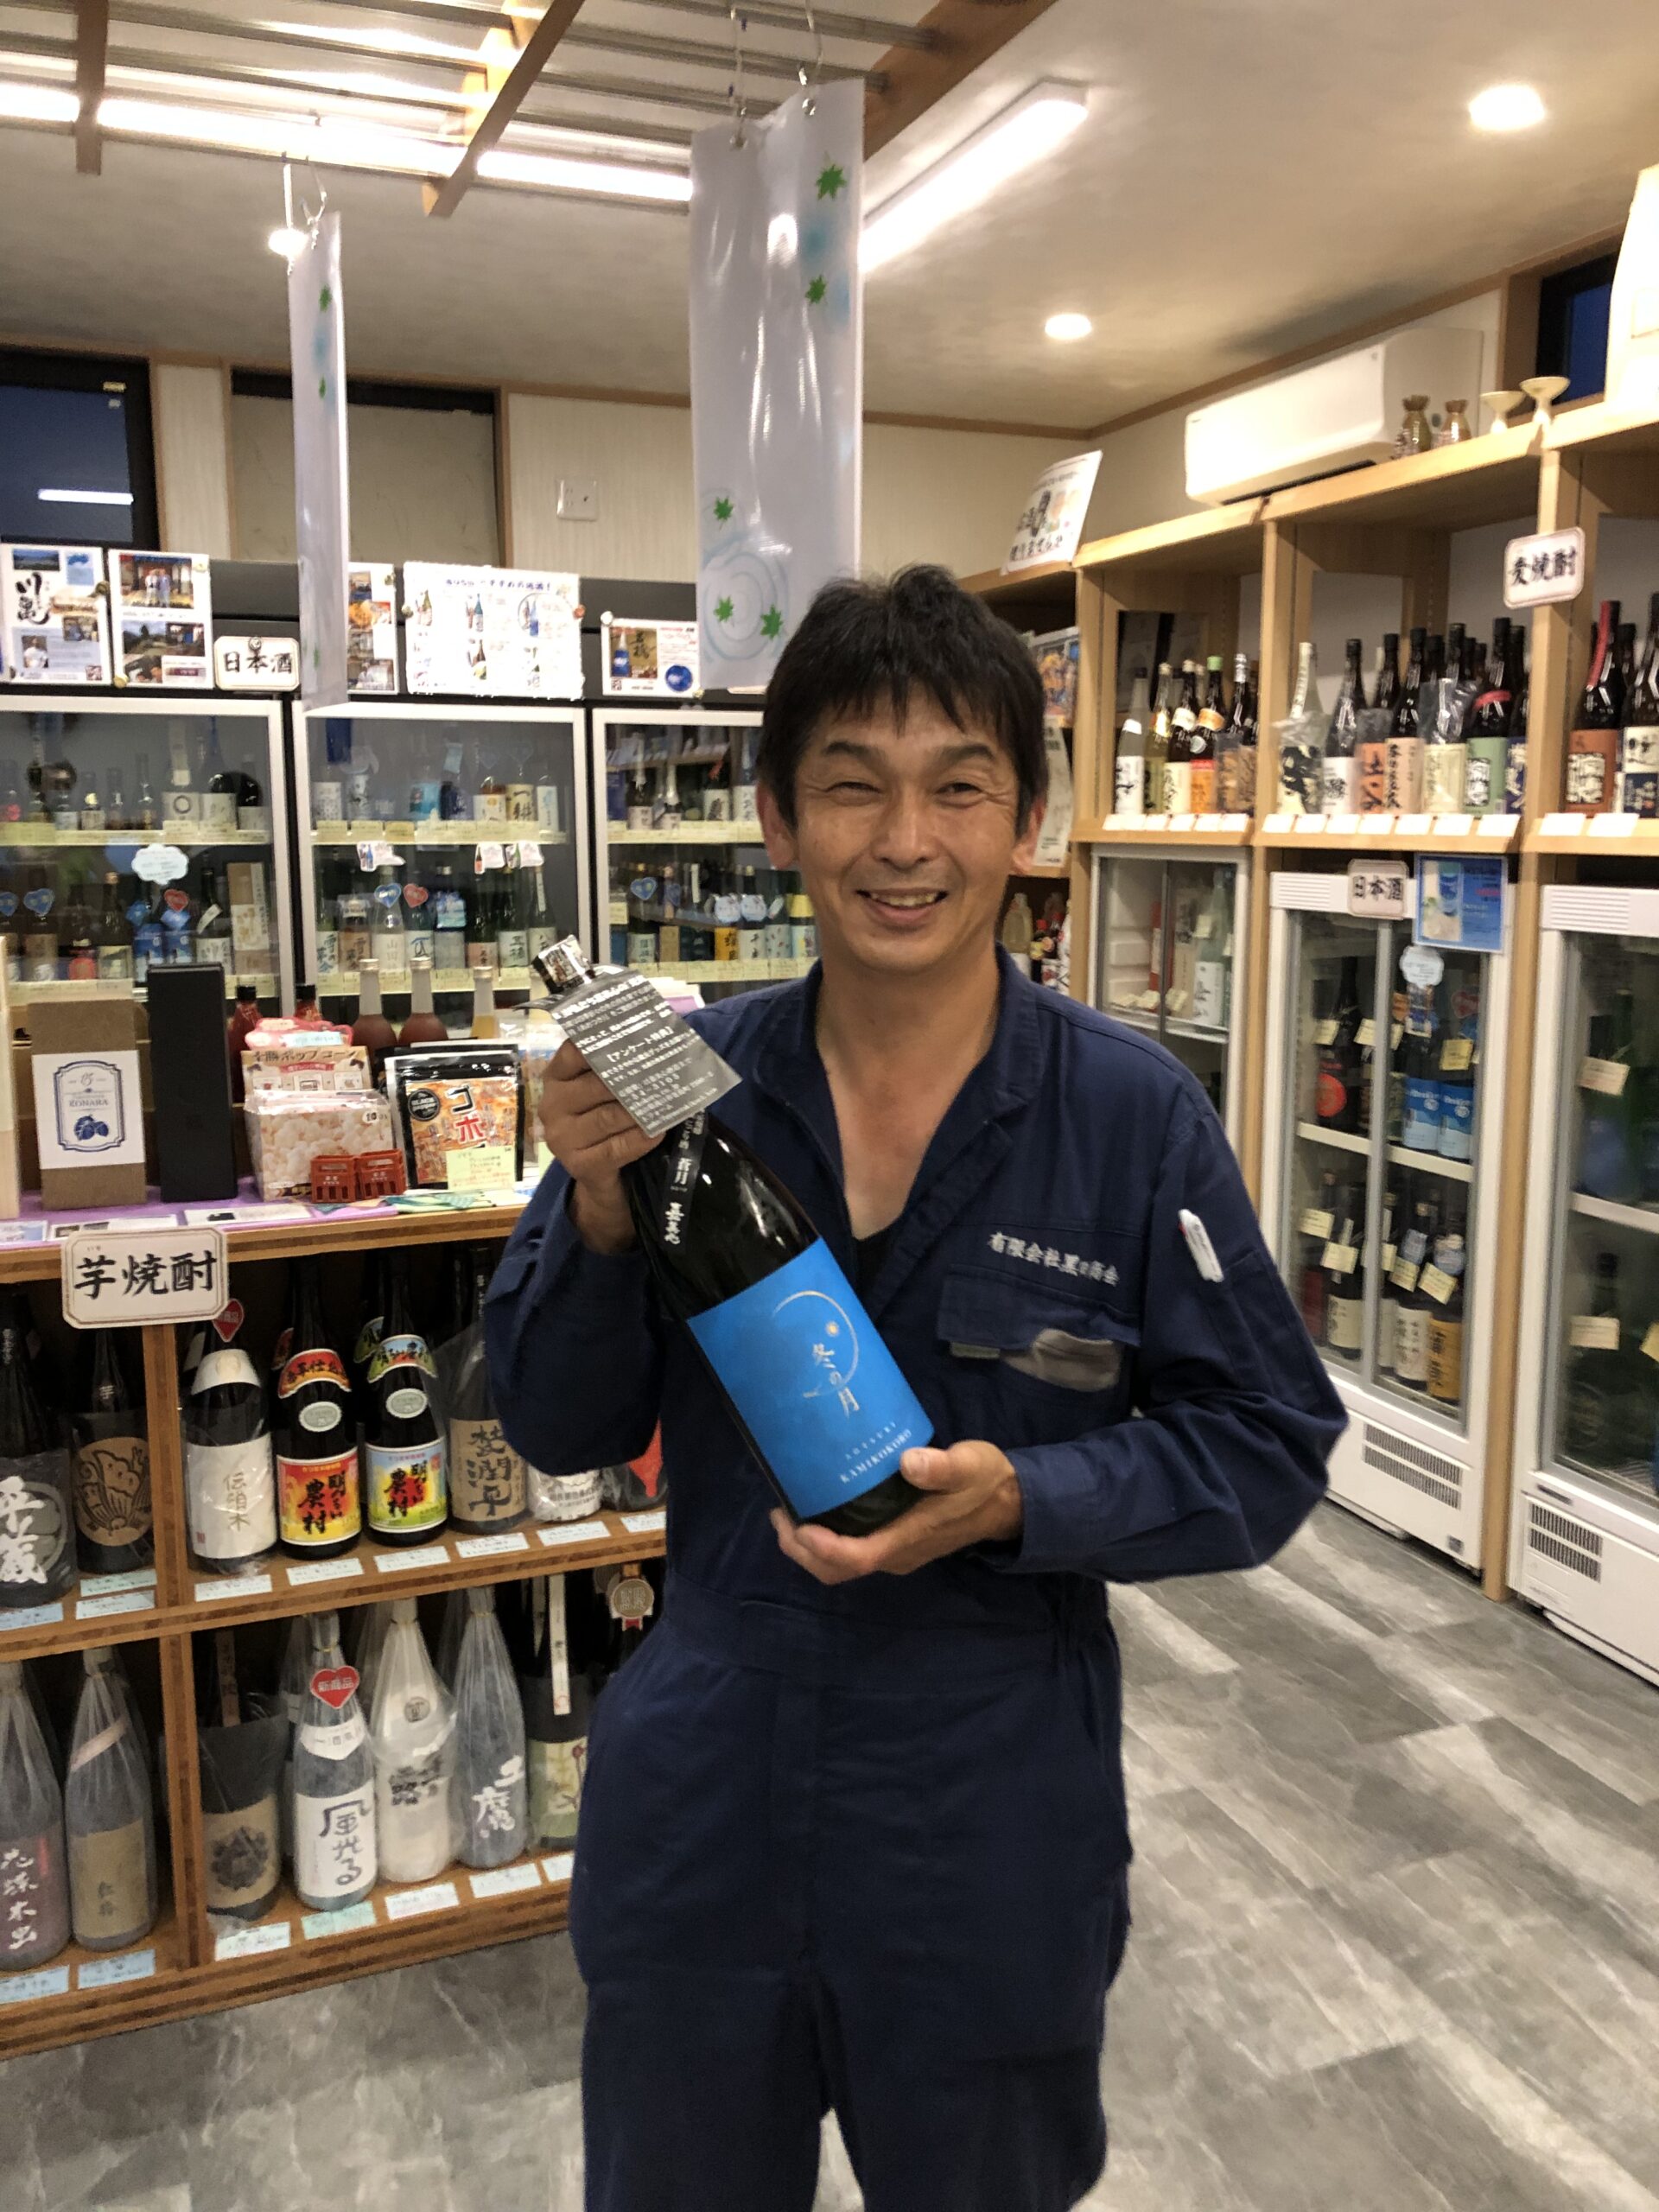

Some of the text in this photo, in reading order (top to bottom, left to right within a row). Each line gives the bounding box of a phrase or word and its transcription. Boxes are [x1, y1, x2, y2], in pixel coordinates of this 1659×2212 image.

[1510, 546, 1578, 586] 麦焼酎
[222, 651, 293, 675] 日本酒
[1353, 874, 1403, 901] 日本酒
[73, 1249, 218, 1300] 芋焼酎
[298, 1478, 327, 1535] 農村
